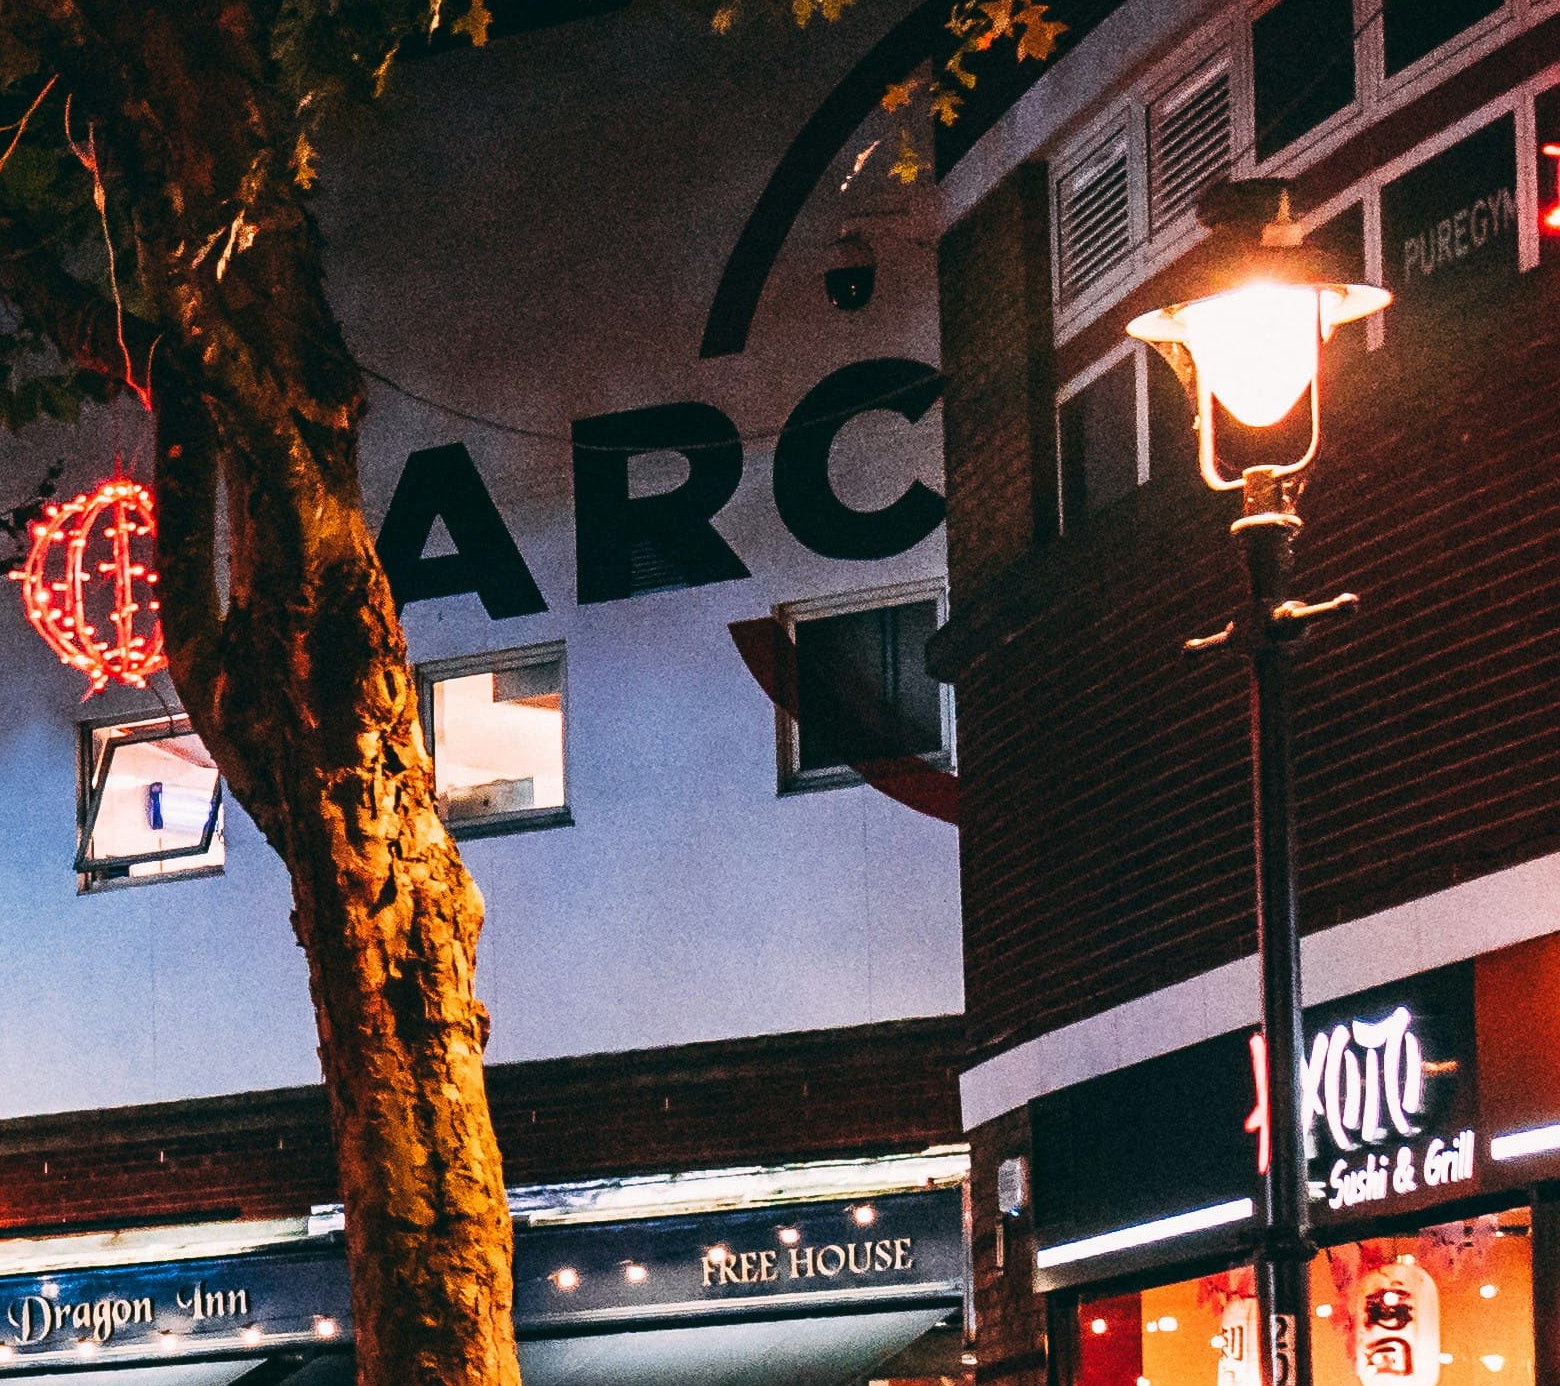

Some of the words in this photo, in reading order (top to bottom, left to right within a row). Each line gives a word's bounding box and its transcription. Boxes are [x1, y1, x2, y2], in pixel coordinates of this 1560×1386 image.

[1329, 1153, 1389, 1209] Sushi
[1393, 1146, 1417, 1194] &
[1424, 1128, 1475, 1186] Grill
[701, 1250, 778, 1287] FREE
[788, 1238, 914, 1280] HOUSE
[7, 1295, 154, 1346] Dragon
[176, 1280, 248, 1321] Inn
